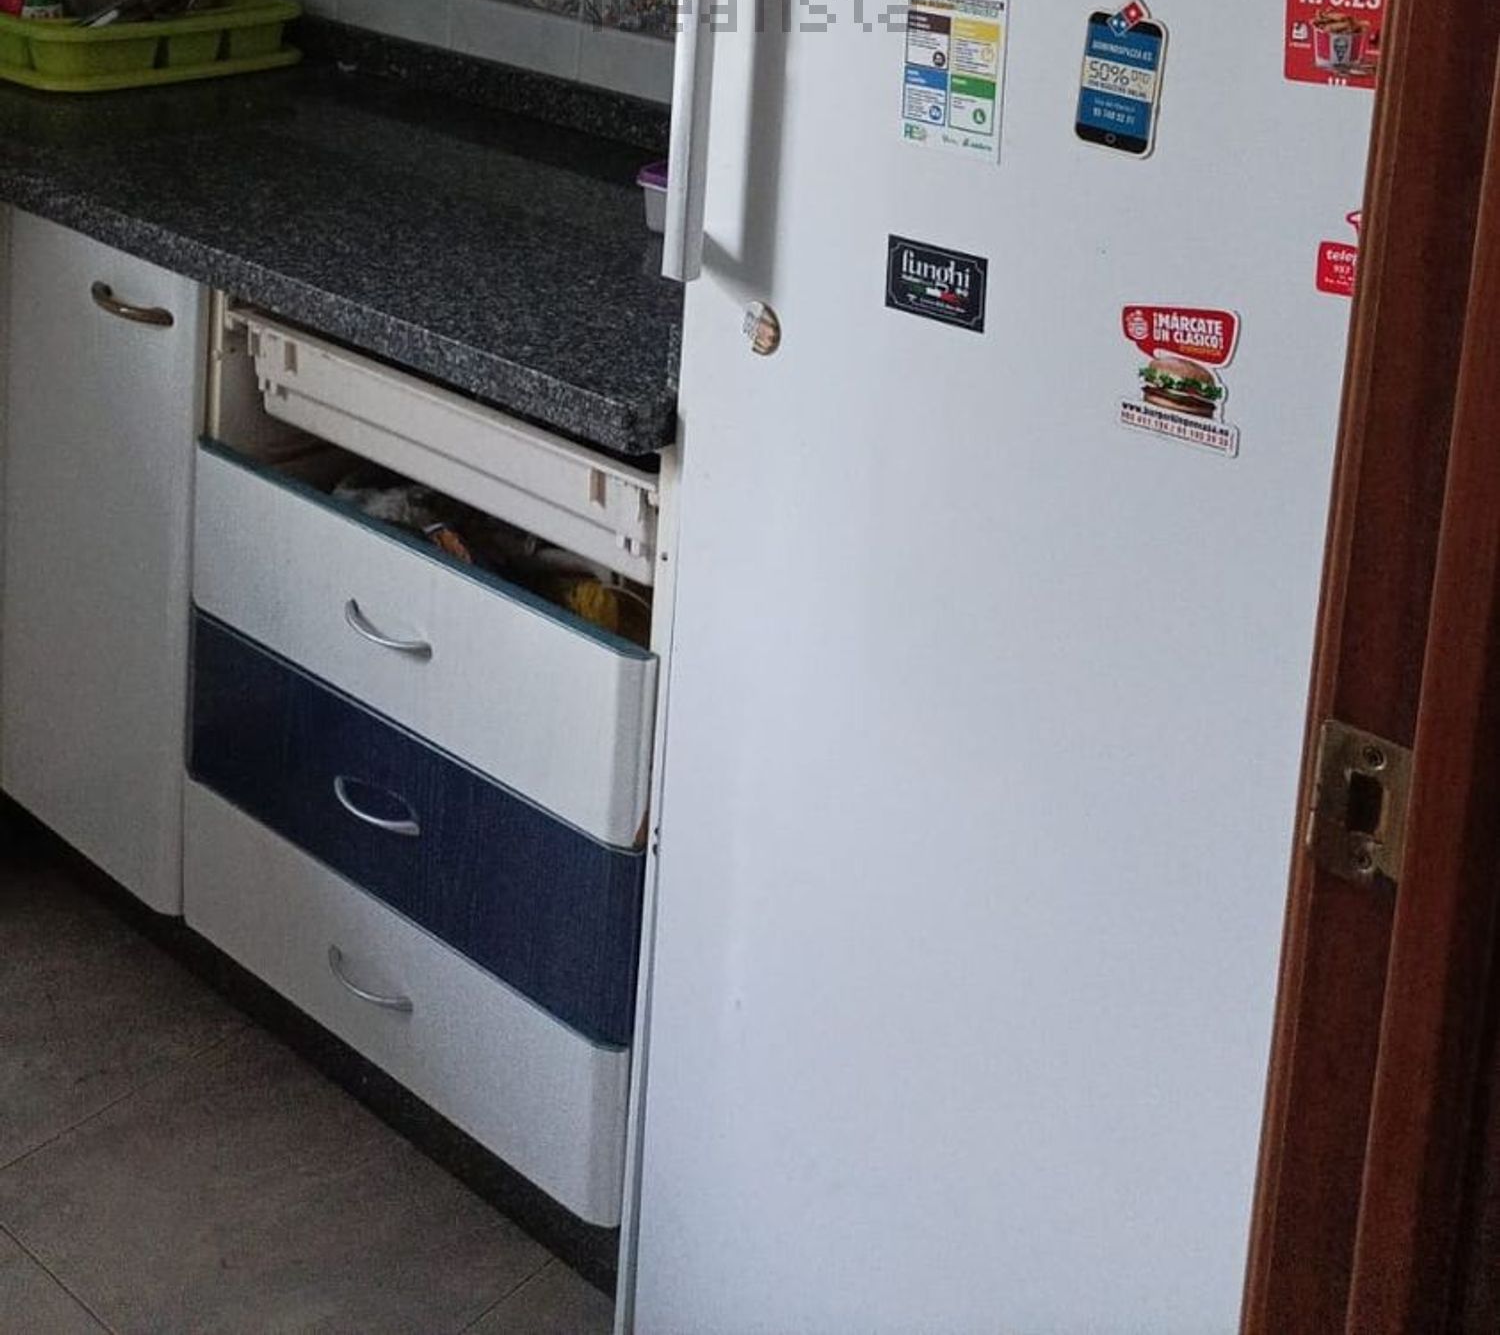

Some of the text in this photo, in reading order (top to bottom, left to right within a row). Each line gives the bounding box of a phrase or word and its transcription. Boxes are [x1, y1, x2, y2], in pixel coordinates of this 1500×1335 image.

[1089, 60, 1130, 86] 50%
[902, 249, 971, 294] funghi
[1154, 327, 1170, 342] UN
